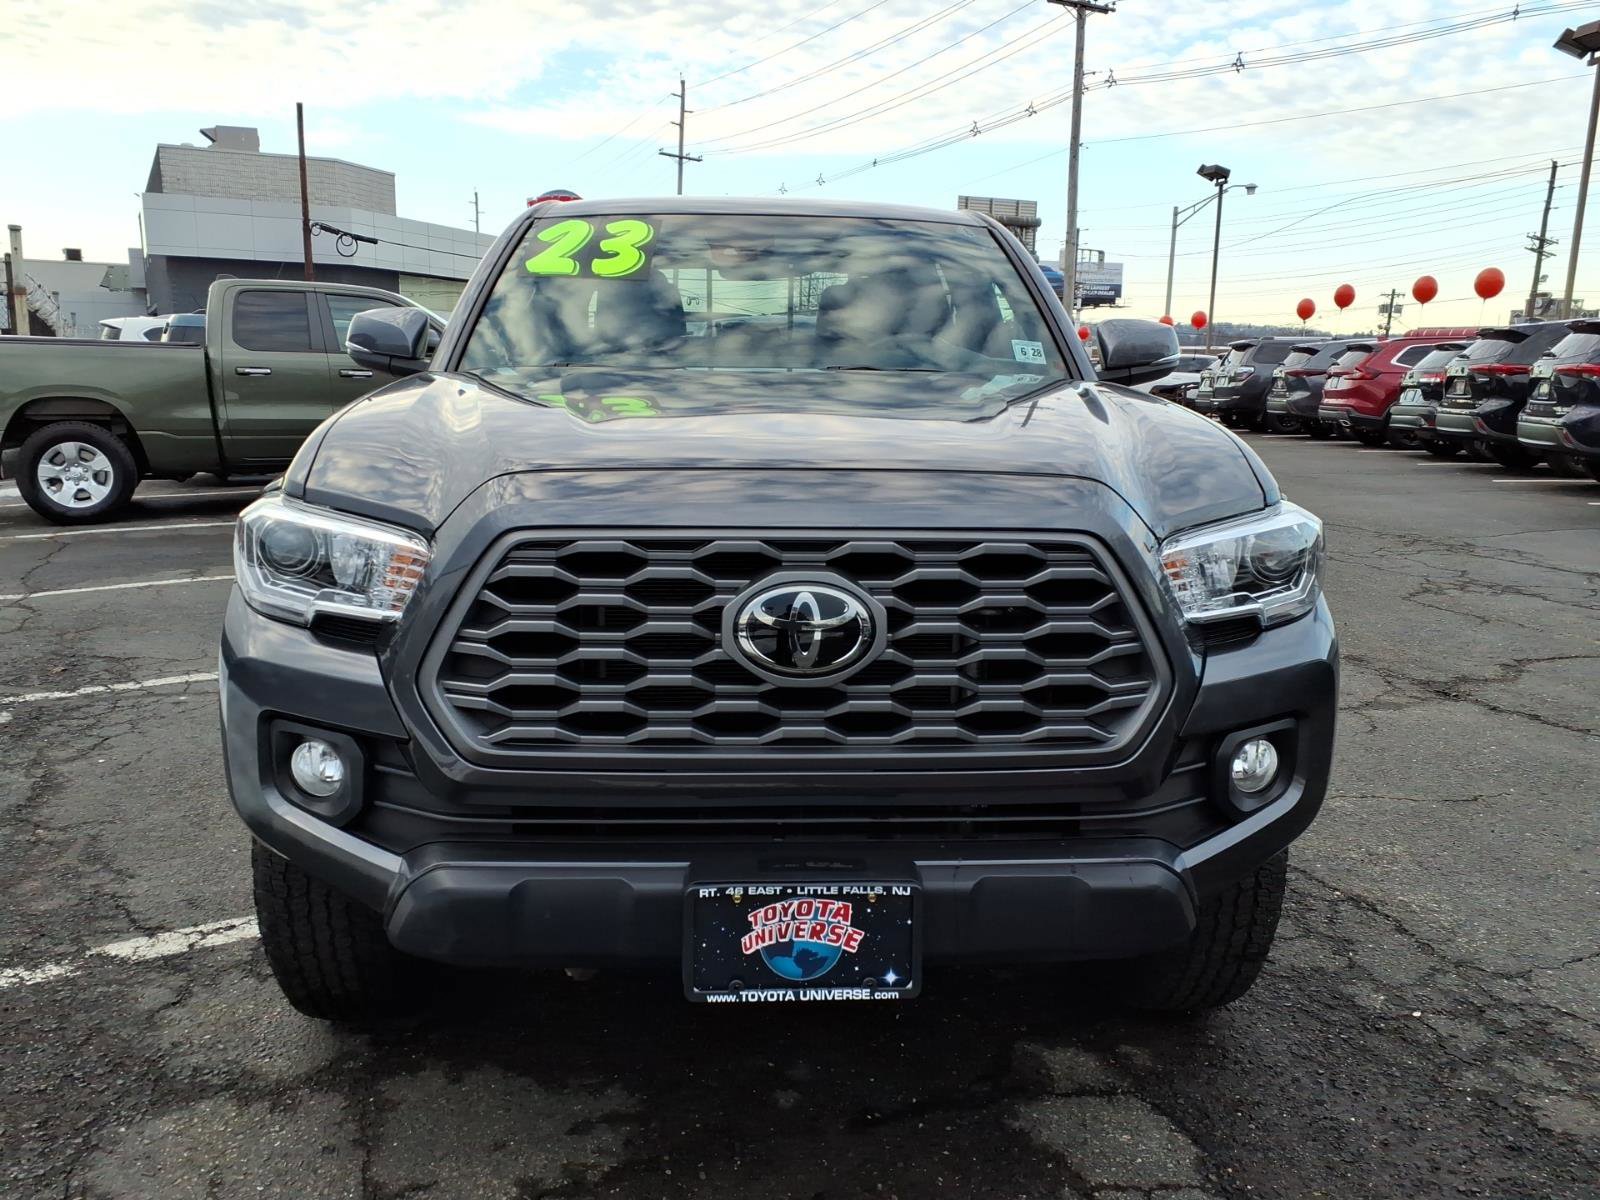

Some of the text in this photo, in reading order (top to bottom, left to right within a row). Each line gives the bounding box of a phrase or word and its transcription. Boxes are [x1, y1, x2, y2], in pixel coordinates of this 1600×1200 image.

[525, 219, 654, 277] 23
[1020, 347, 1042, 358] 6 28
[699, 886, 911, 898] RT. 46 EAST LITTLE FALLS, NJ
[748, 899, 852, 929] TOYOTA
[741, 920, 865, 954] UNIVERSE
[706, 988, 900, 1003] www.TOYOTA UNIVERSE.com
